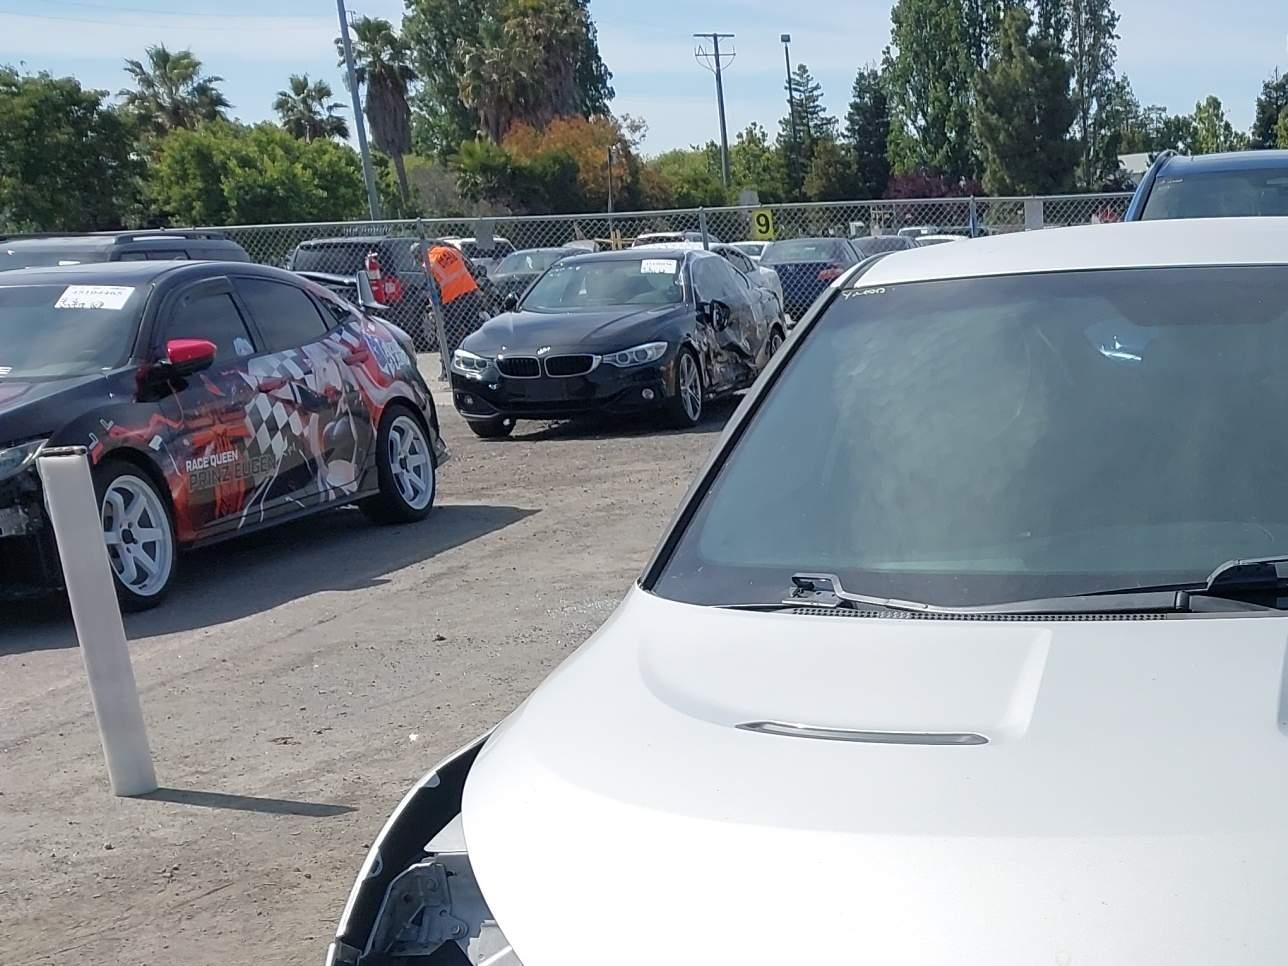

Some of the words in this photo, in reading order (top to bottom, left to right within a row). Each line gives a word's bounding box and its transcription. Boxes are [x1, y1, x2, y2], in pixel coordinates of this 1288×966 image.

[756, 213, 770, 235] 9
[185, 454, 210, 472] RACE
[210, 449, 239, 466] QUEEN
[189, 466, 231, 491] PRINZ
